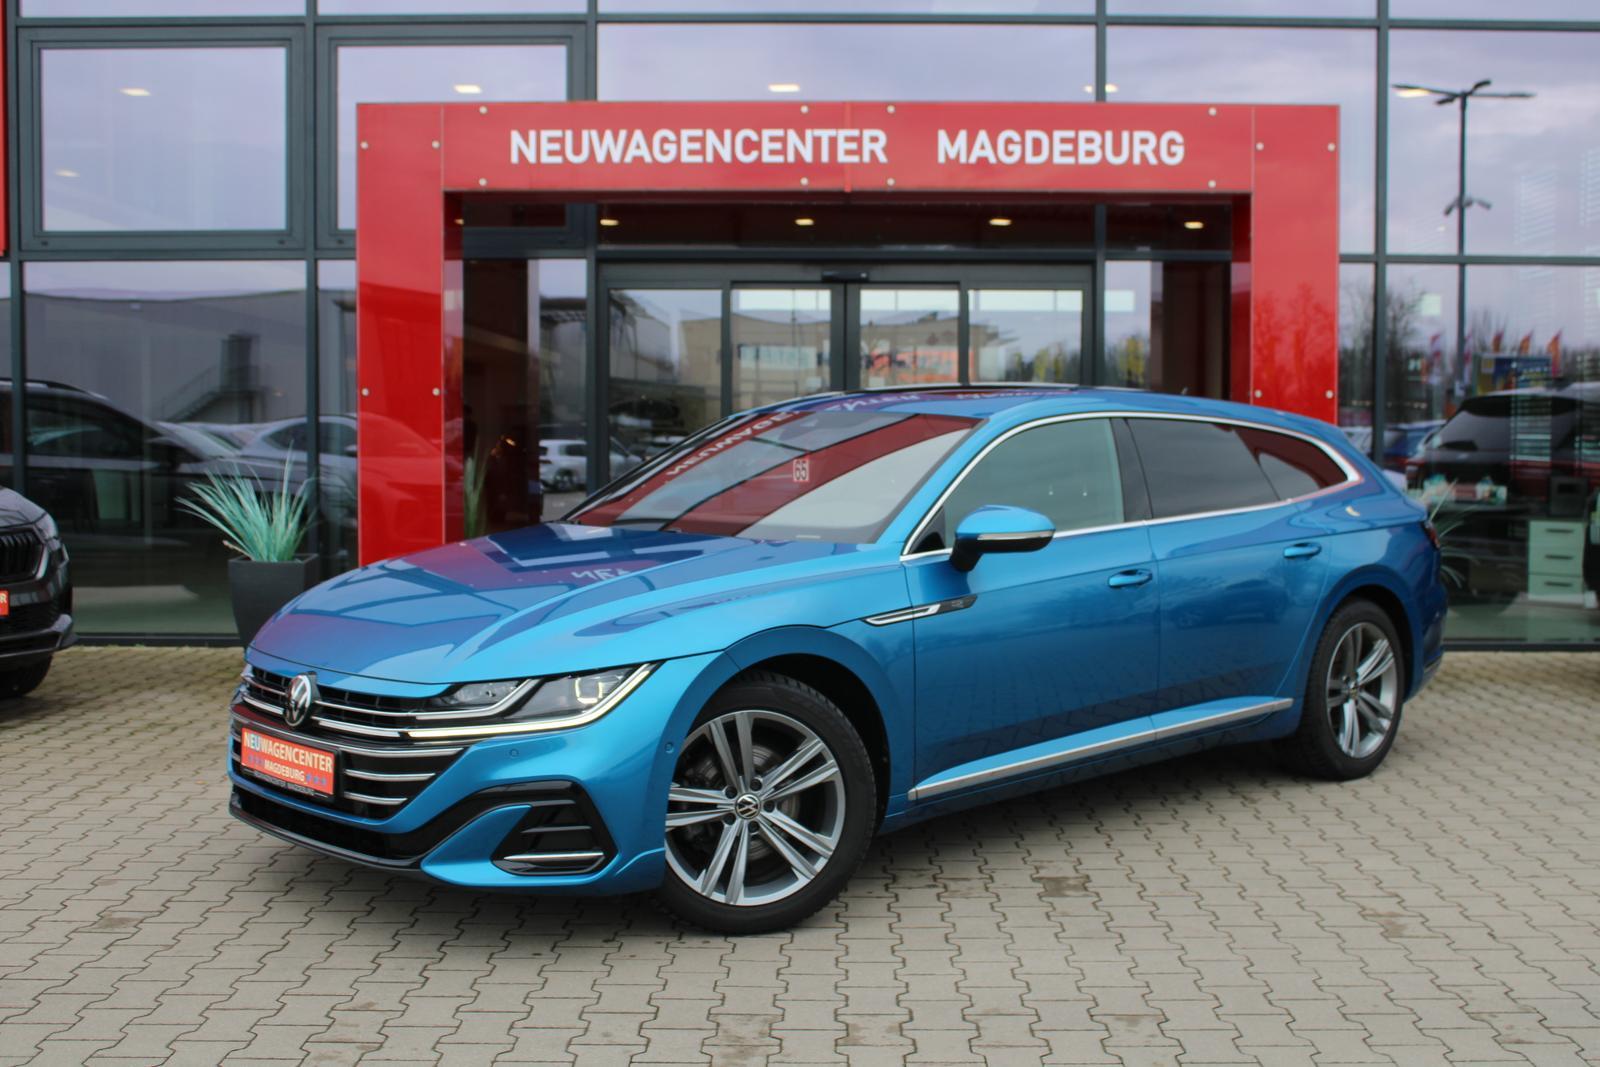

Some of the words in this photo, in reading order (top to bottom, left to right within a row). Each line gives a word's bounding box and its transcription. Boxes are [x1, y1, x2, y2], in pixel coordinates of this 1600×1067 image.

[510, 129, 889, 164] NEUWAGENCENTER
[937, 129, 1185, 165] MAGDEBURG
[244, 732, 333, 772] NEUWAGENCENTER
